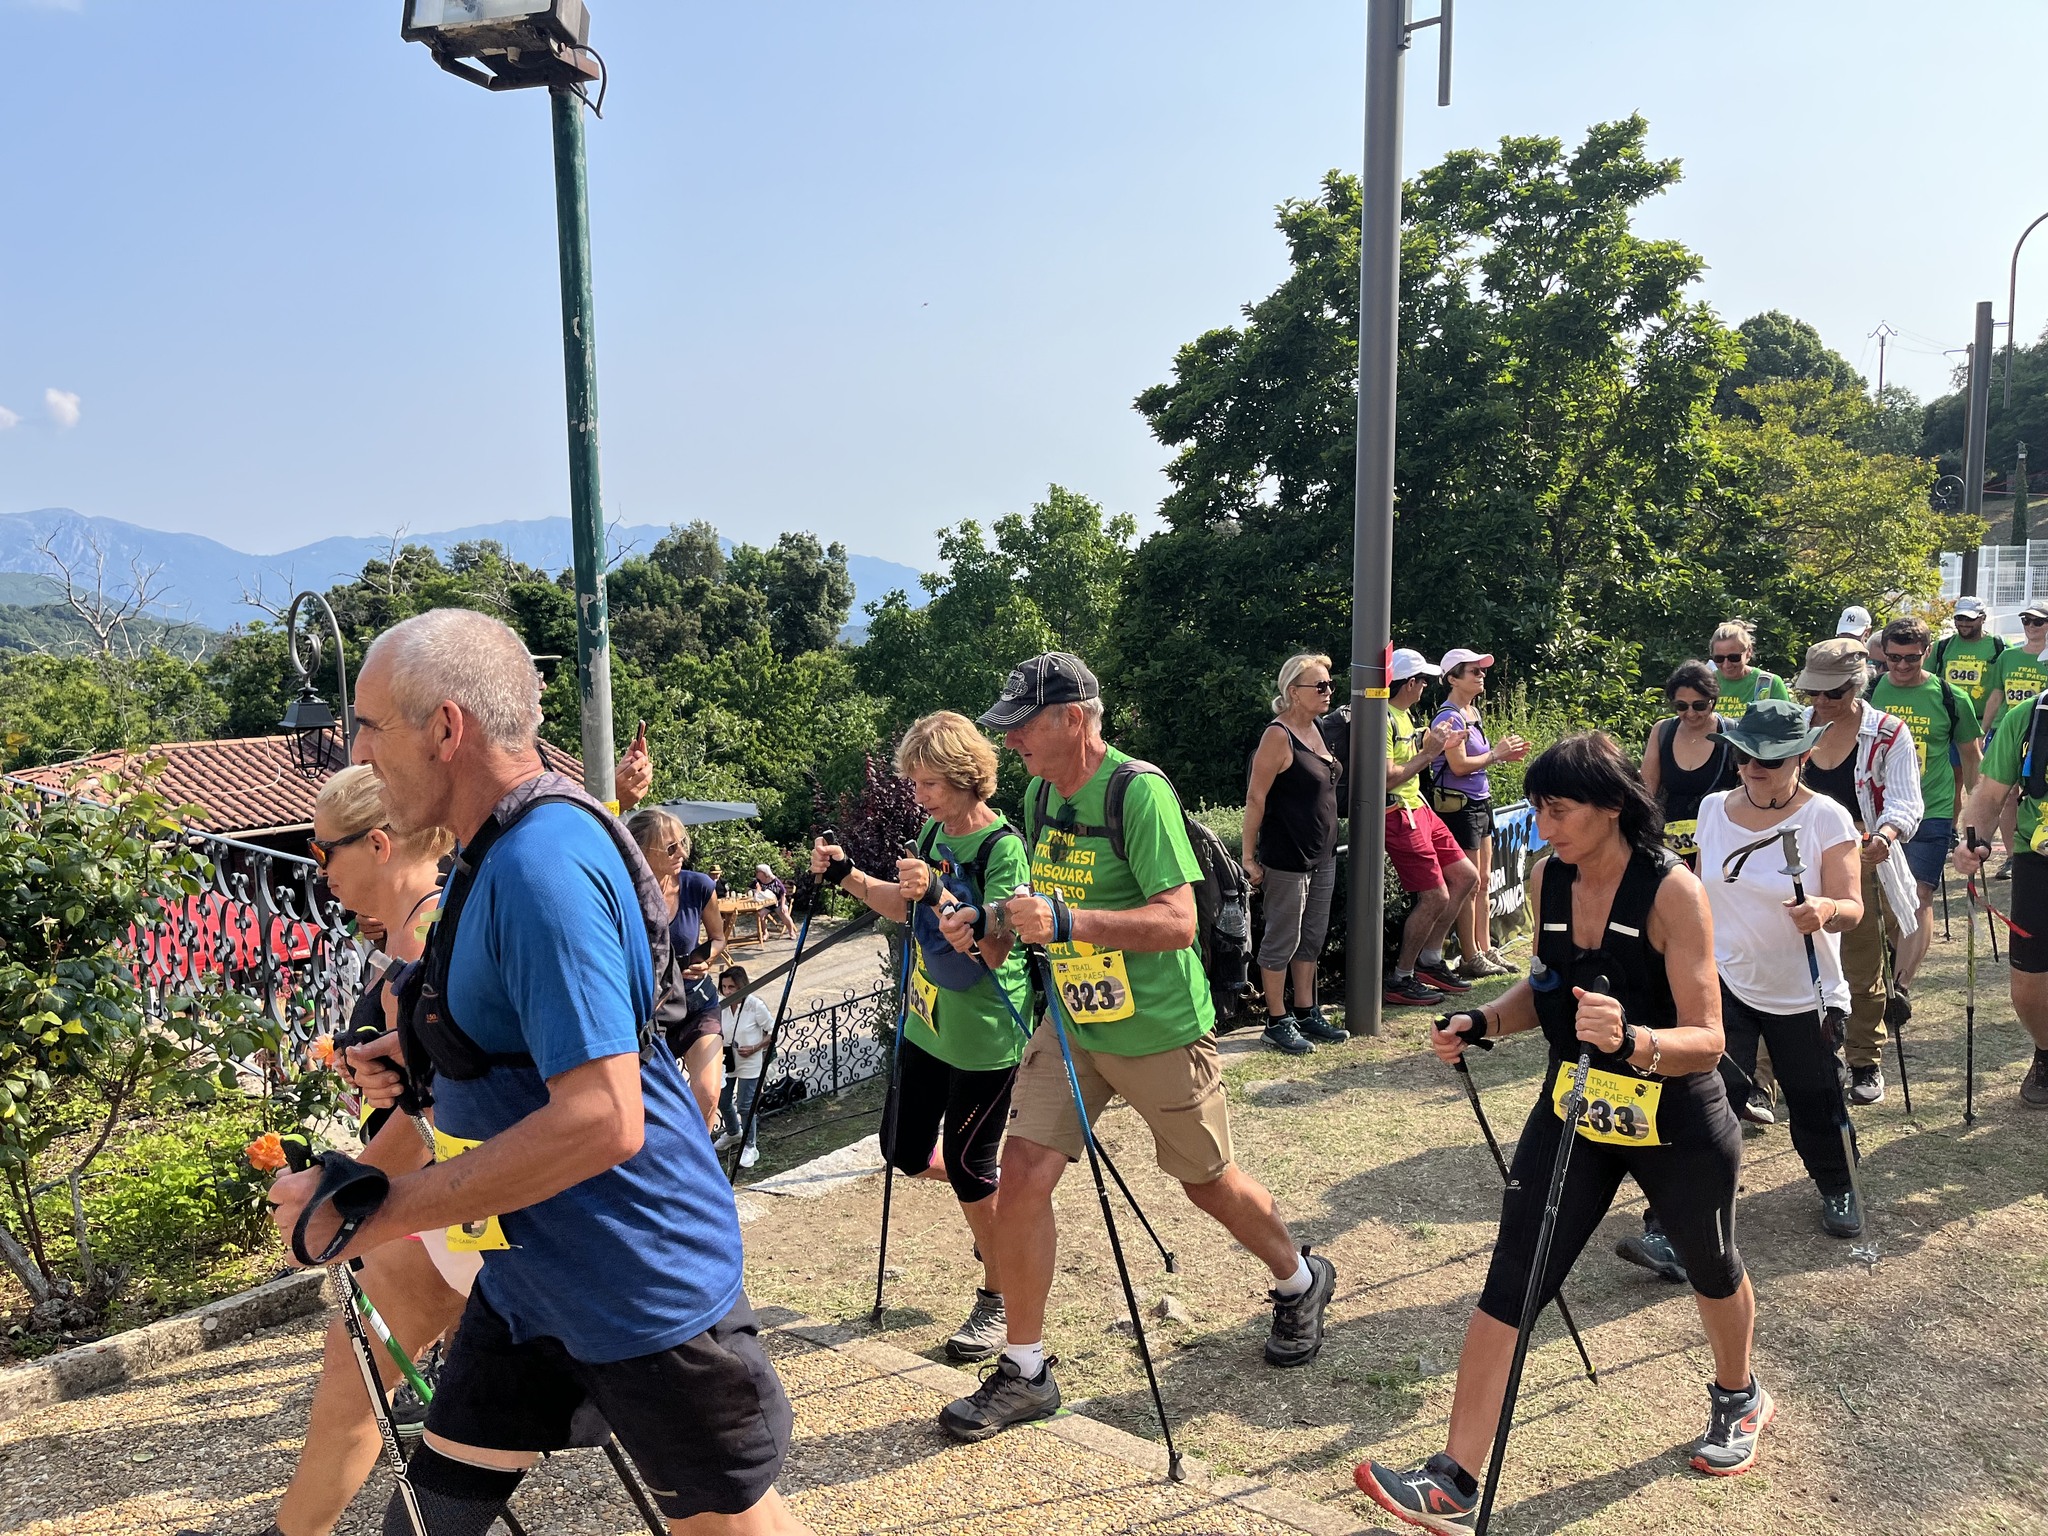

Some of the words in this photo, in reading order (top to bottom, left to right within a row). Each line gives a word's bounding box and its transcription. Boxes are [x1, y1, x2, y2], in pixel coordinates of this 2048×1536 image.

[1951, 669, 1975, 681] 346
[2017, 666, 2037, 674] TRAIL
[1719, 696, 1740, 704] TRAIL
[1885, 705, 1913, 714] TRAIL
[1900, 715, 1930, 726] PAESI
[1071, 963, 1093, 973] TRAIL
[1071, 973, 1082, 982] TRE
[1084, 970, 1107, 981] PAESI
[1066, 980, 1116, 1013] 323
[1590, 1076, 1620, 1092] TRAIL
[1584, 1086, 1601, 1098] TRE
[1603, 1091, 1636, 1105] PAESI
